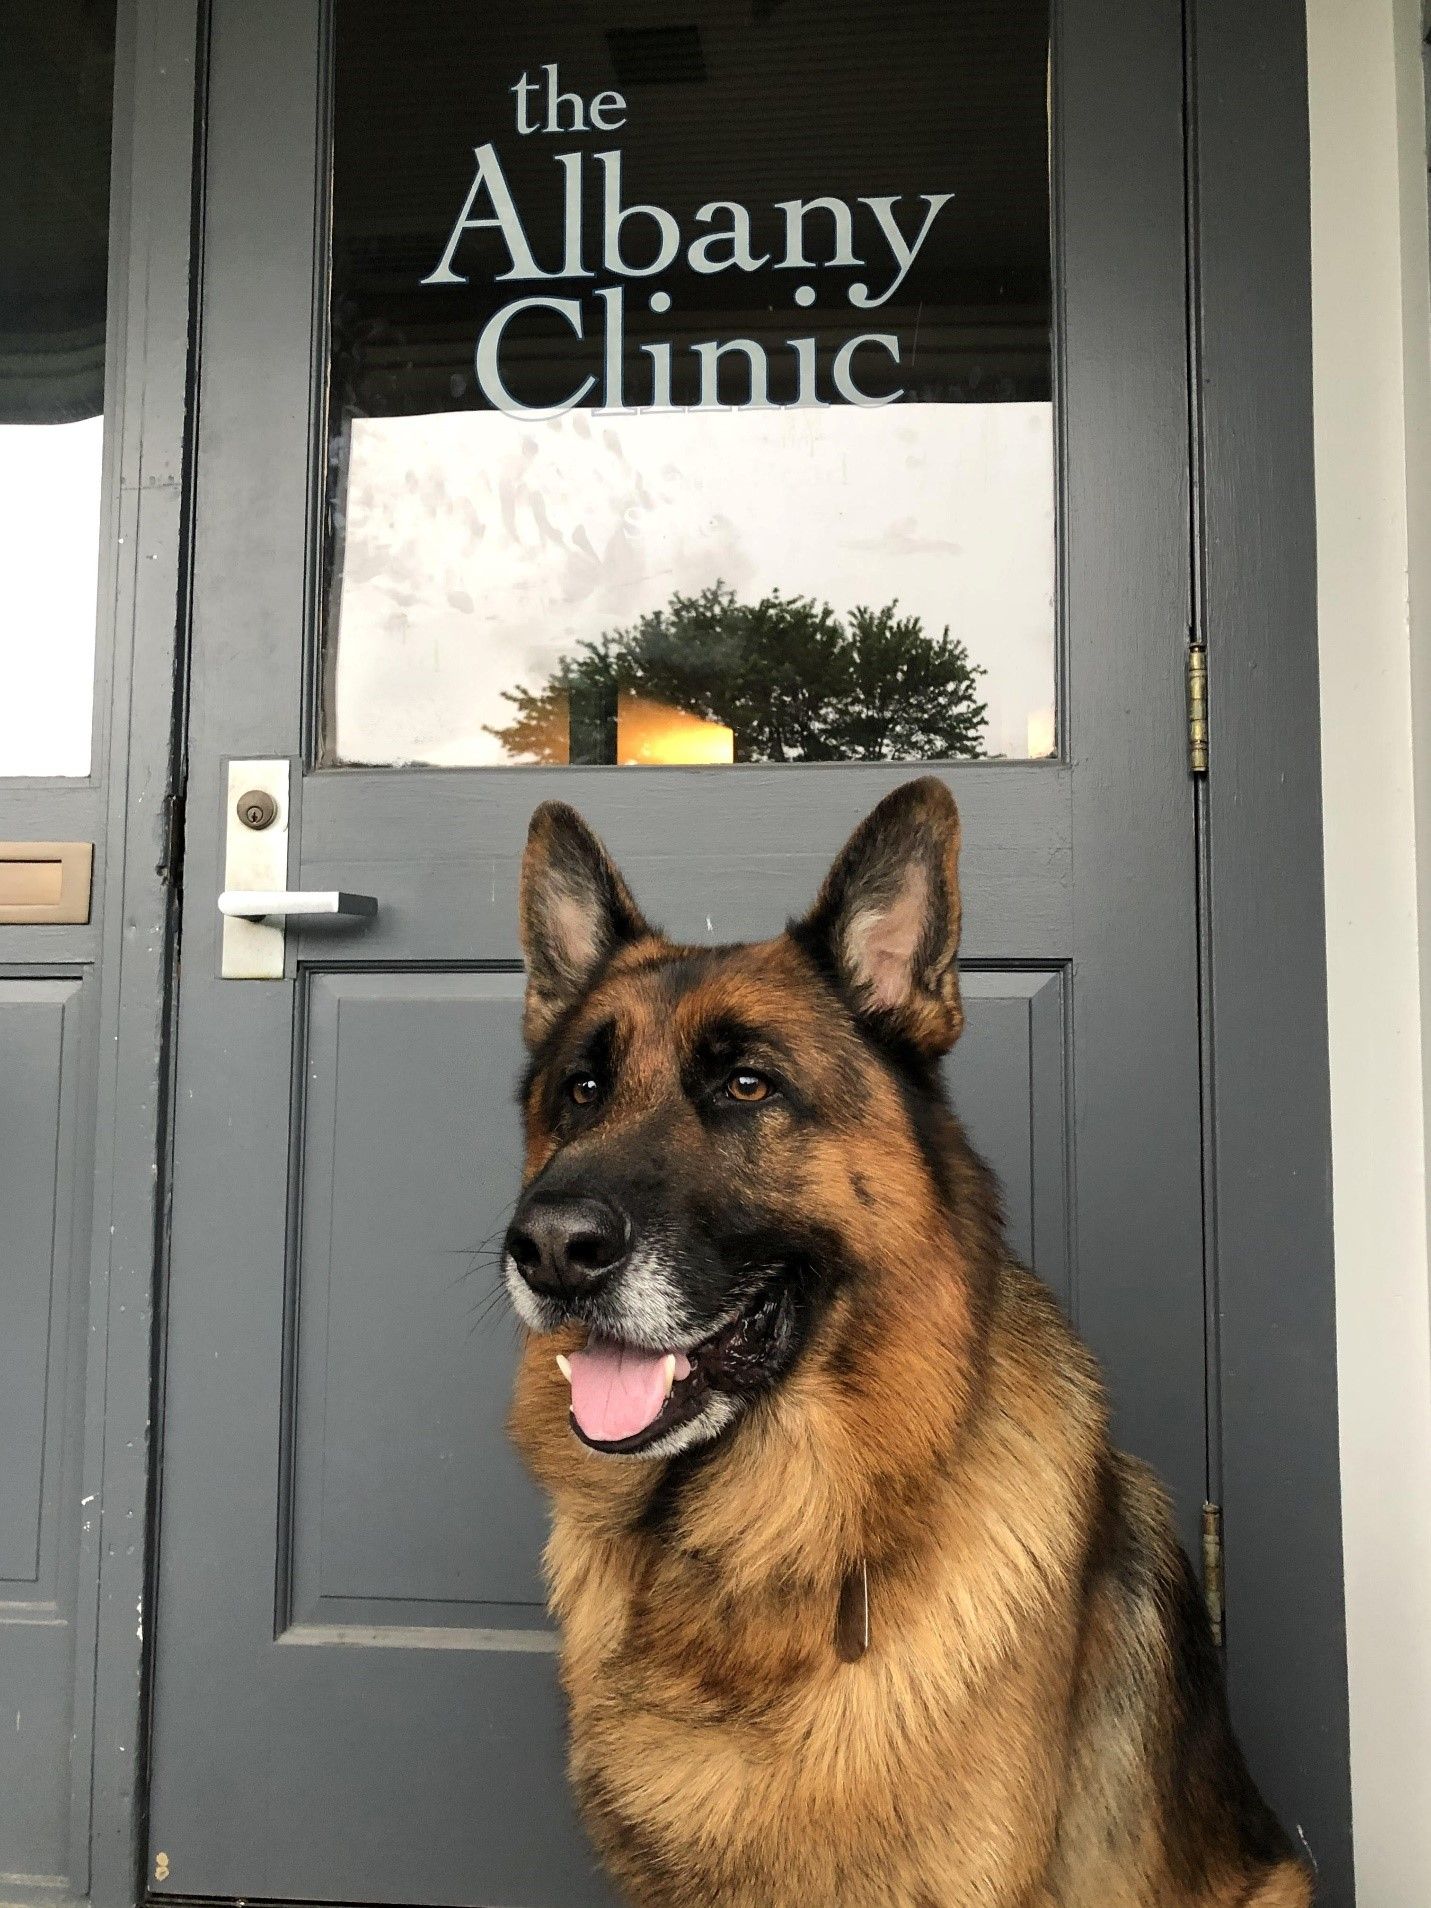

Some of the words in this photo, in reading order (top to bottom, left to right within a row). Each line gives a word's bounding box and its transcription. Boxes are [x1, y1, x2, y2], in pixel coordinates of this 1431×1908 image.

[510, 63, 627, 135] the
[419, 143, 956, 308] Albany
[475, 286, 904, 422] Clinic
